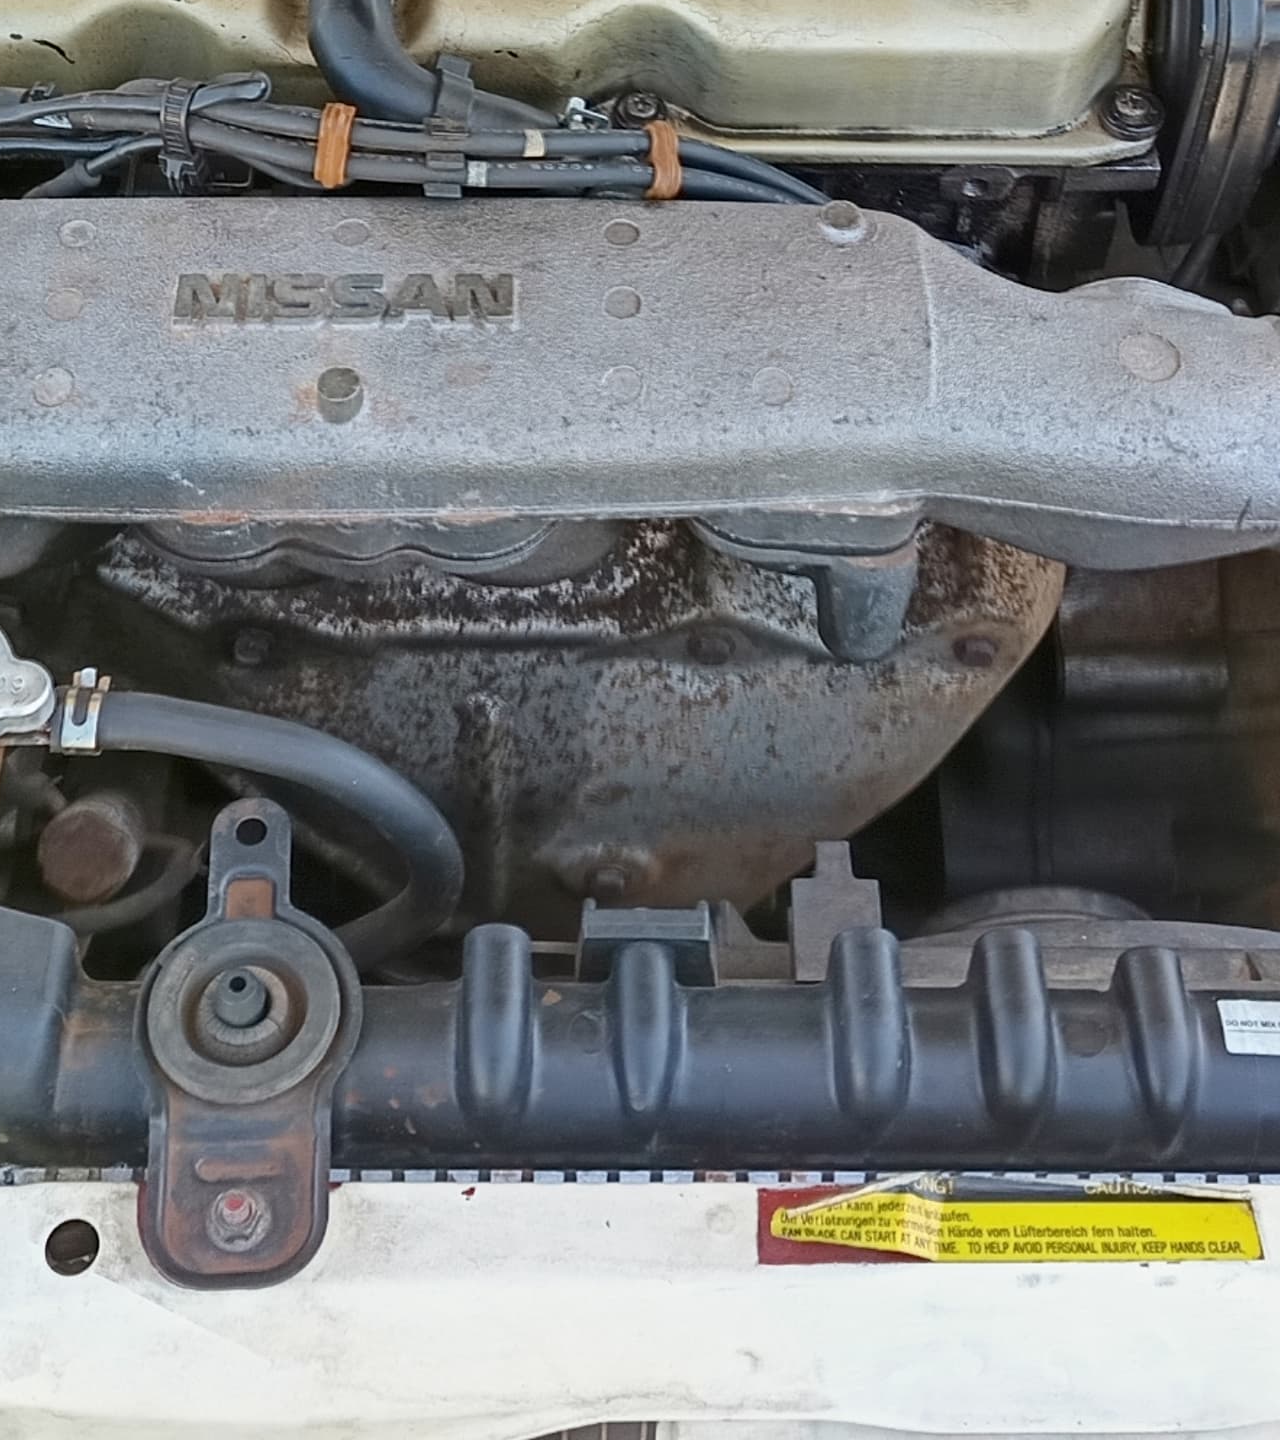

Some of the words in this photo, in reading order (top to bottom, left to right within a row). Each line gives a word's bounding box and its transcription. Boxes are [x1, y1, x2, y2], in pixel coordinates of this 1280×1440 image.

[173, 273, 517, 324] NISSAN
[1083, 1176, 1163, 1195] CAUTIO
[878, 1217, 891, 1226] zu
[947, 1226, 985, 1238] Hände
[987, 1229, 1010, 1238] vom
[1013, 1226, 1088, 1239] Lüfterbereich
[1092, 1226, 1115, 1238] fern
[1118, 1226, 1157, 1239] halten.
[781, 1228, 802, 1237] FAN
[805, 1228, 837, 1239] BLADE
[840, 1230, 862, 1241] CAN
[865, 1231, 897, 1244] START
[900, 1234, 912, 1244] AT
[968, 1241, 982, 1254] TO
[984, 1241, 1009, 1254] HELP
[1013, 1241, 1043, 1254] AVOID
[1045, 1241, 1098, 1254] PERSONAL
[1101, 1241, 1140, 1256] INJURY,
[1142, 1241, 1167, 1254] KEEP
[1170, 1241, 1206, 1254] HANDS
[1209, 1241, 1246, 1255] CLEAR.
